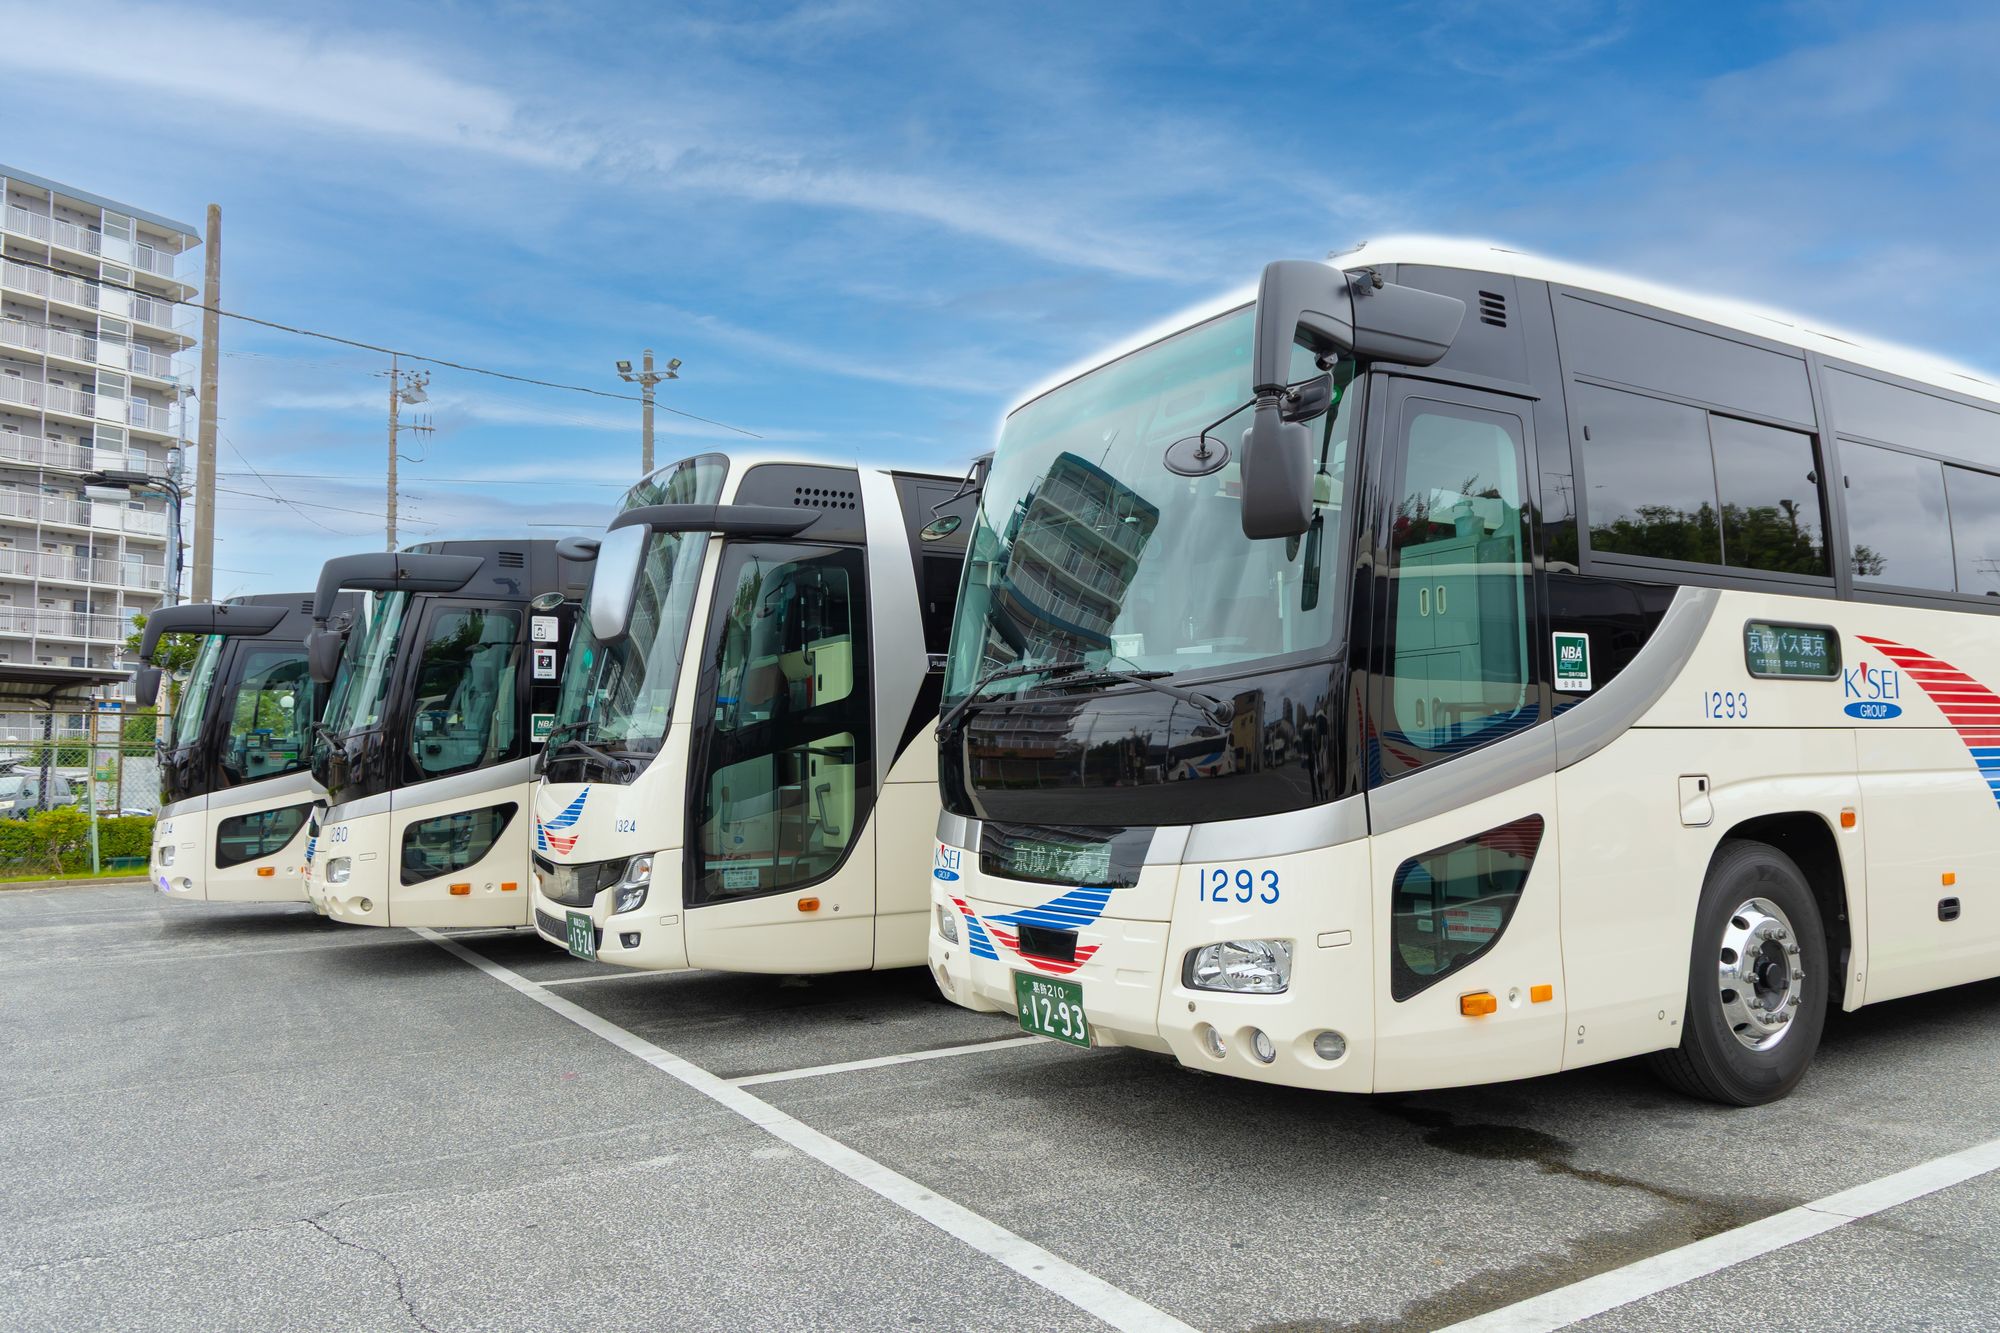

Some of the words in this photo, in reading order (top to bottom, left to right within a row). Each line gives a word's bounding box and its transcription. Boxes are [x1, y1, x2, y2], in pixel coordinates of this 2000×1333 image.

[1561, 646, 1583, 659] NBA
[1747, 630, 1827, 657] 京成バス東京
[1705, 691, 1748, 719] 1293
[1860, 704, 1888, 718] GROUP
[615, 819, 636, 833] 1324
[1200, 868, 1280, 905] 1293
